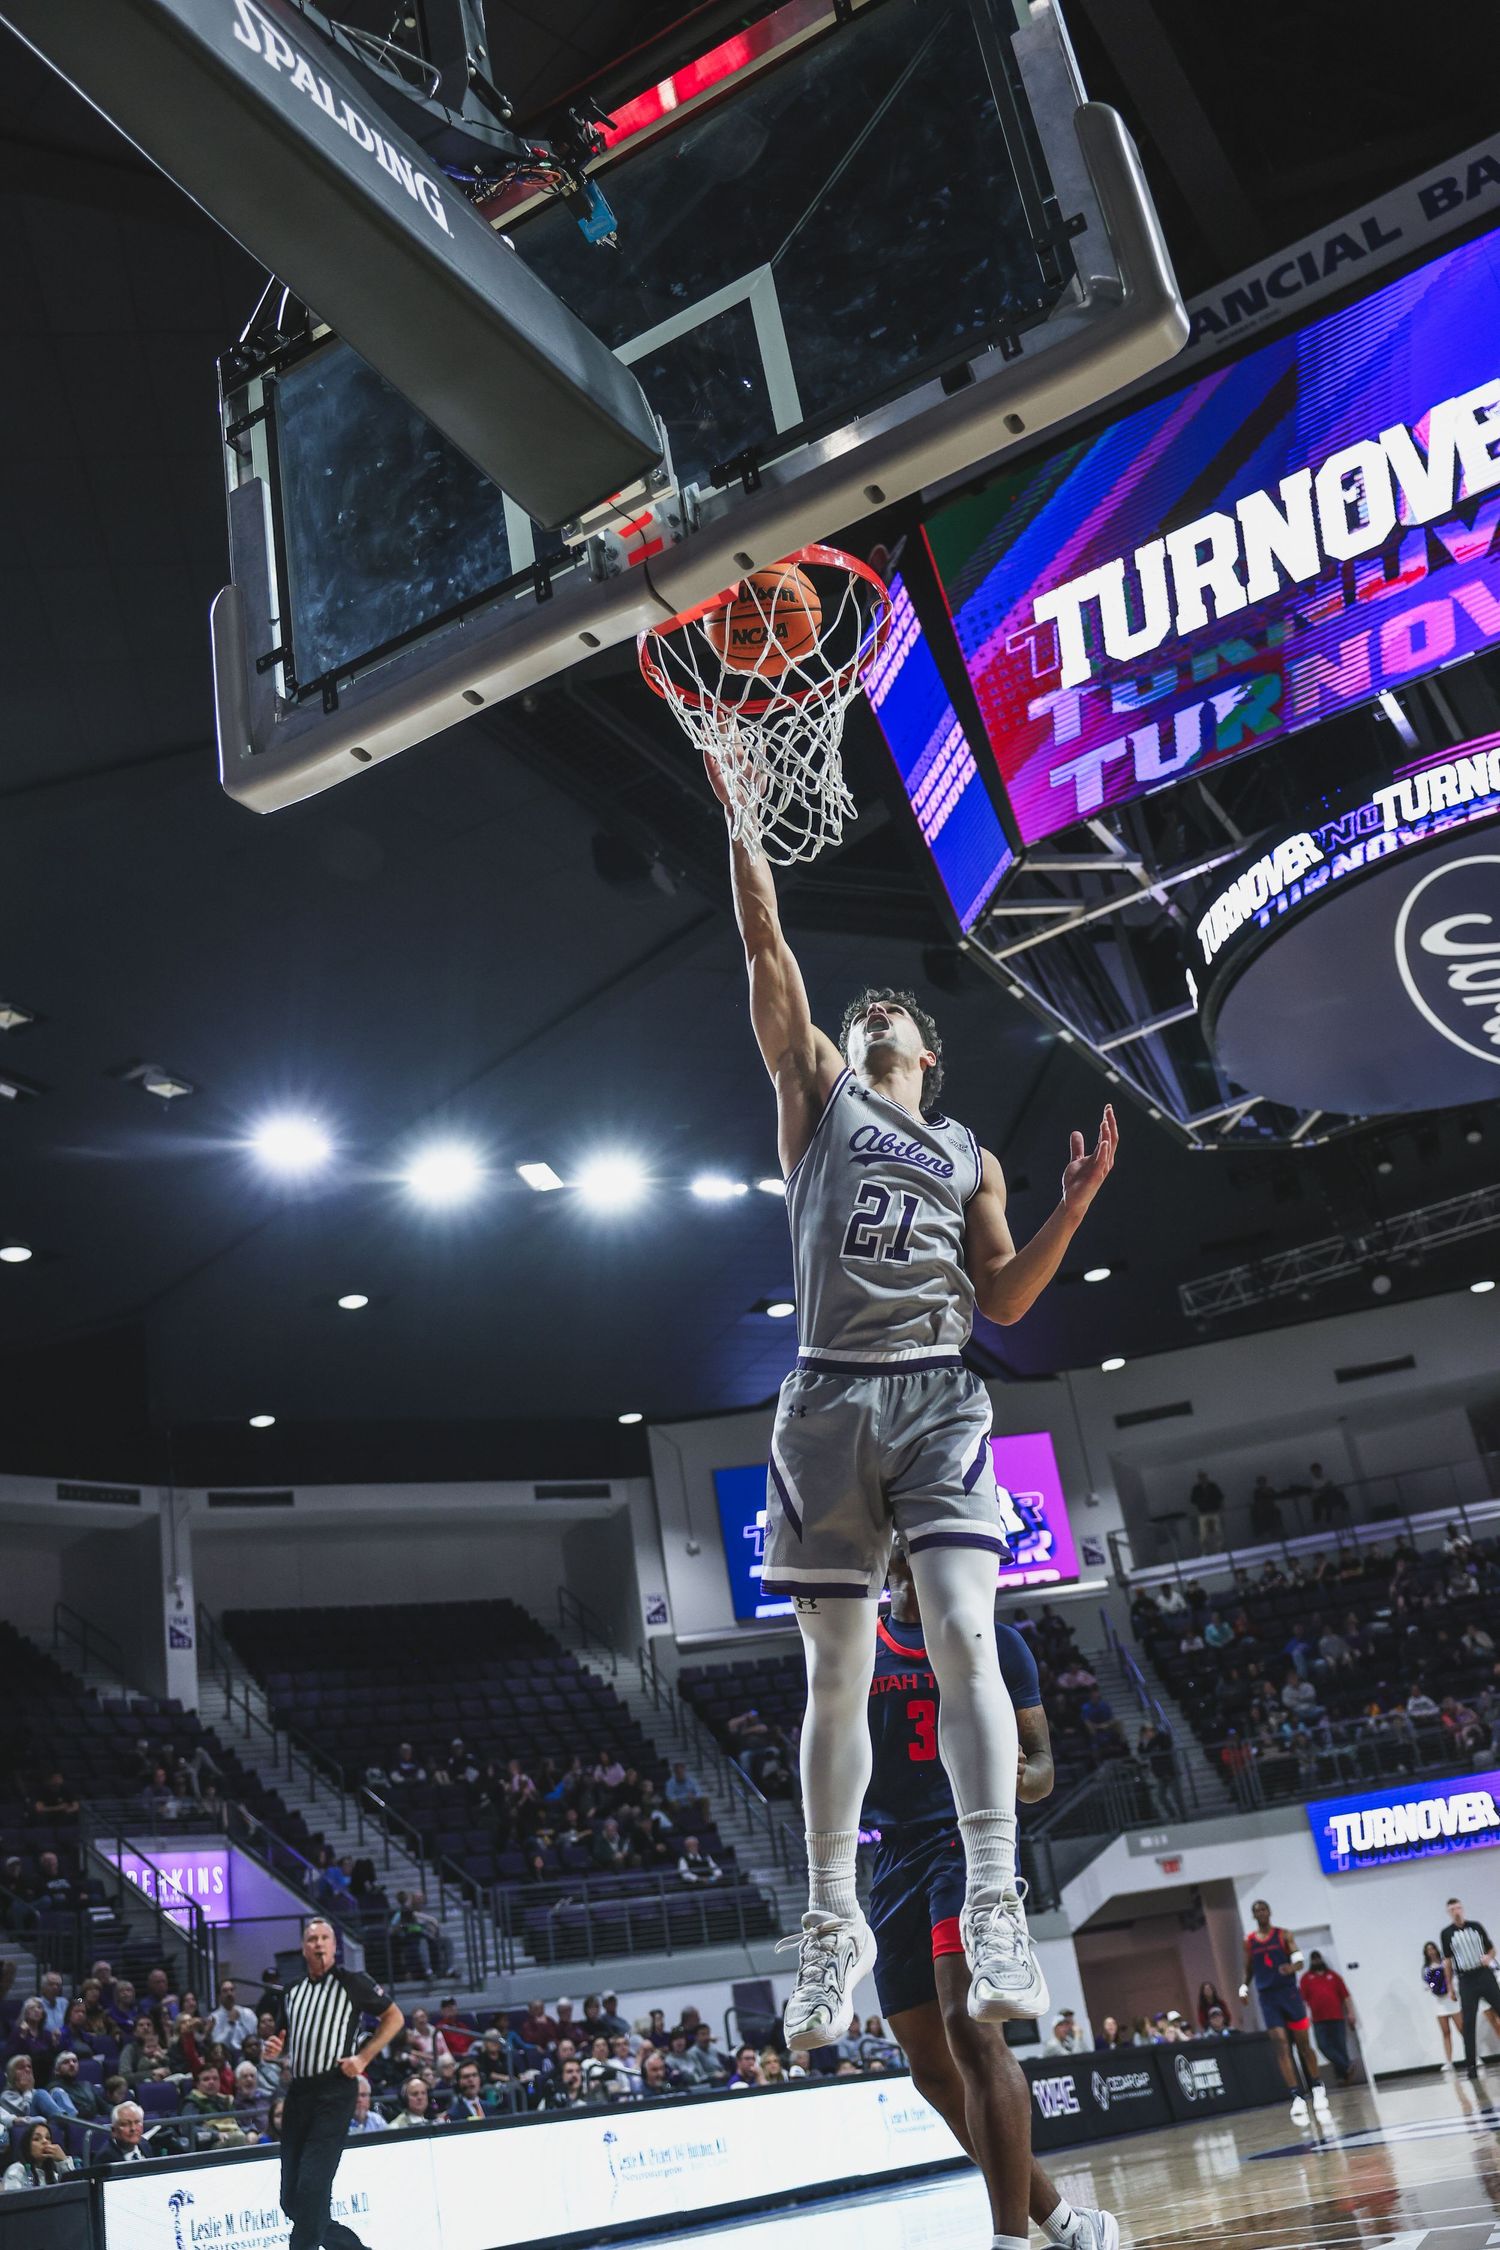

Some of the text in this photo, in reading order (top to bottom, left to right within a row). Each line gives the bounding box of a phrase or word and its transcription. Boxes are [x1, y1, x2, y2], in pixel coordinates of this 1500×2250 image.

[233, 0, 454, 238] SPALDING
[1197, 832, 1324, 965] TURNOVER
[849, 1125, 955, 1178] Abilene
[840, 1179, 923, 1265] 21
[907, 1700, 936, 1761] 3
[1329, 1791, 1500, 1855] TURNOVER
[1032, 2066, 1081, 2119] WAC
